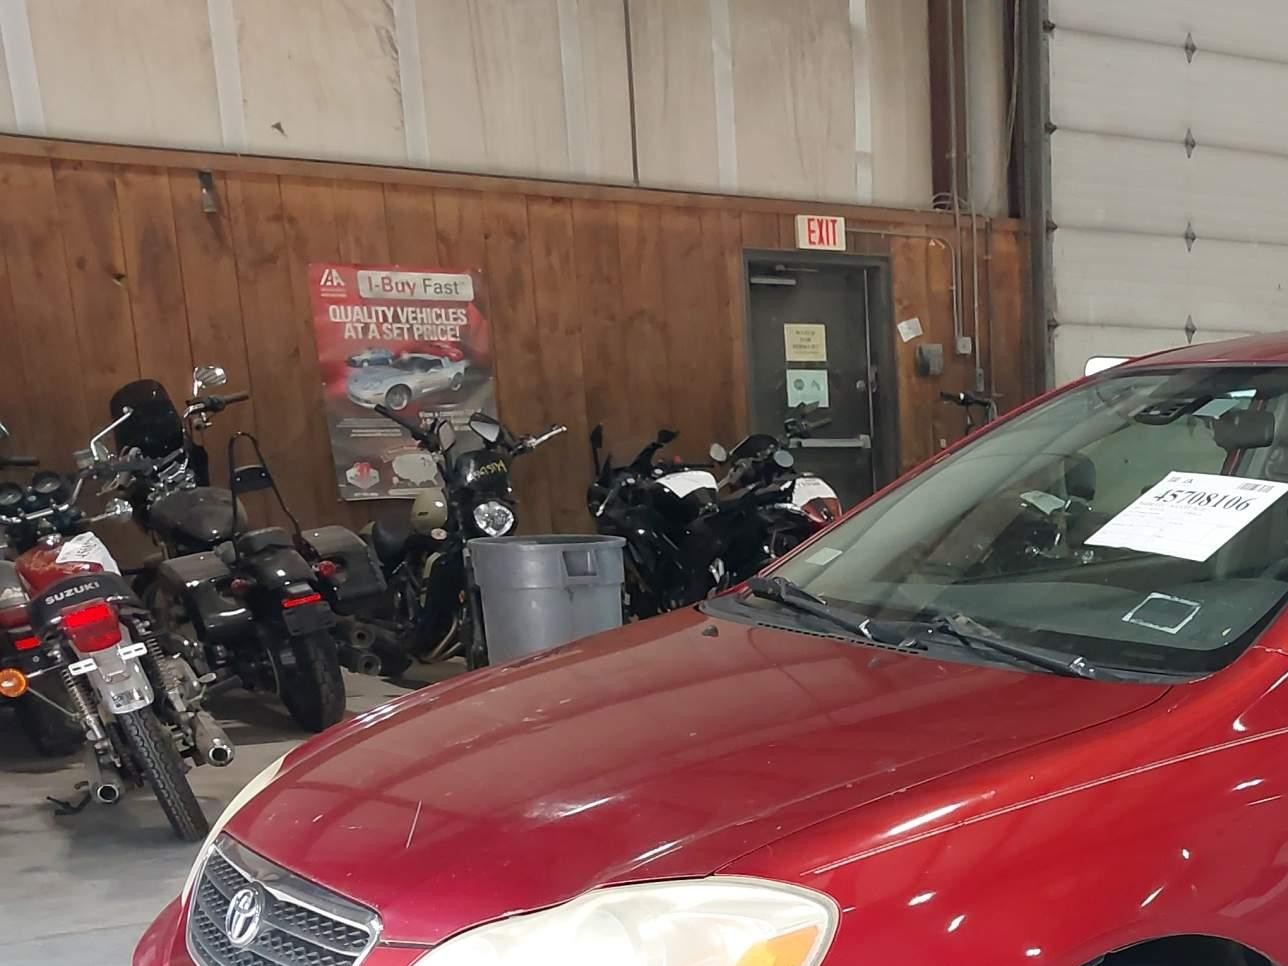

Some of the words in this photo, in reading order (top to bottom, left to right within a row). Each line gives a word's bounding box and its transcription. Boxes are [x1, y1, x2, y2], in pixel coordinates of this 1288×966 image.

[807, 217, 838, 247] EXIT
[368, 276, 417, 296] I-Buy
[422, 278, 460, 296] Fast
[328, 304, 395, 323] QUALITY
[397, 306, 468, 326] VEHICLES
[344, 323, 365, 340] AT
[367, 324, 381, 340] A
[383, 324, 413, 342] SET
[413, 325, 461, 342] PRICE!
[1153, 488, 1255, 512] 45708106
[45, 581, 101, 605] SUZUKI
